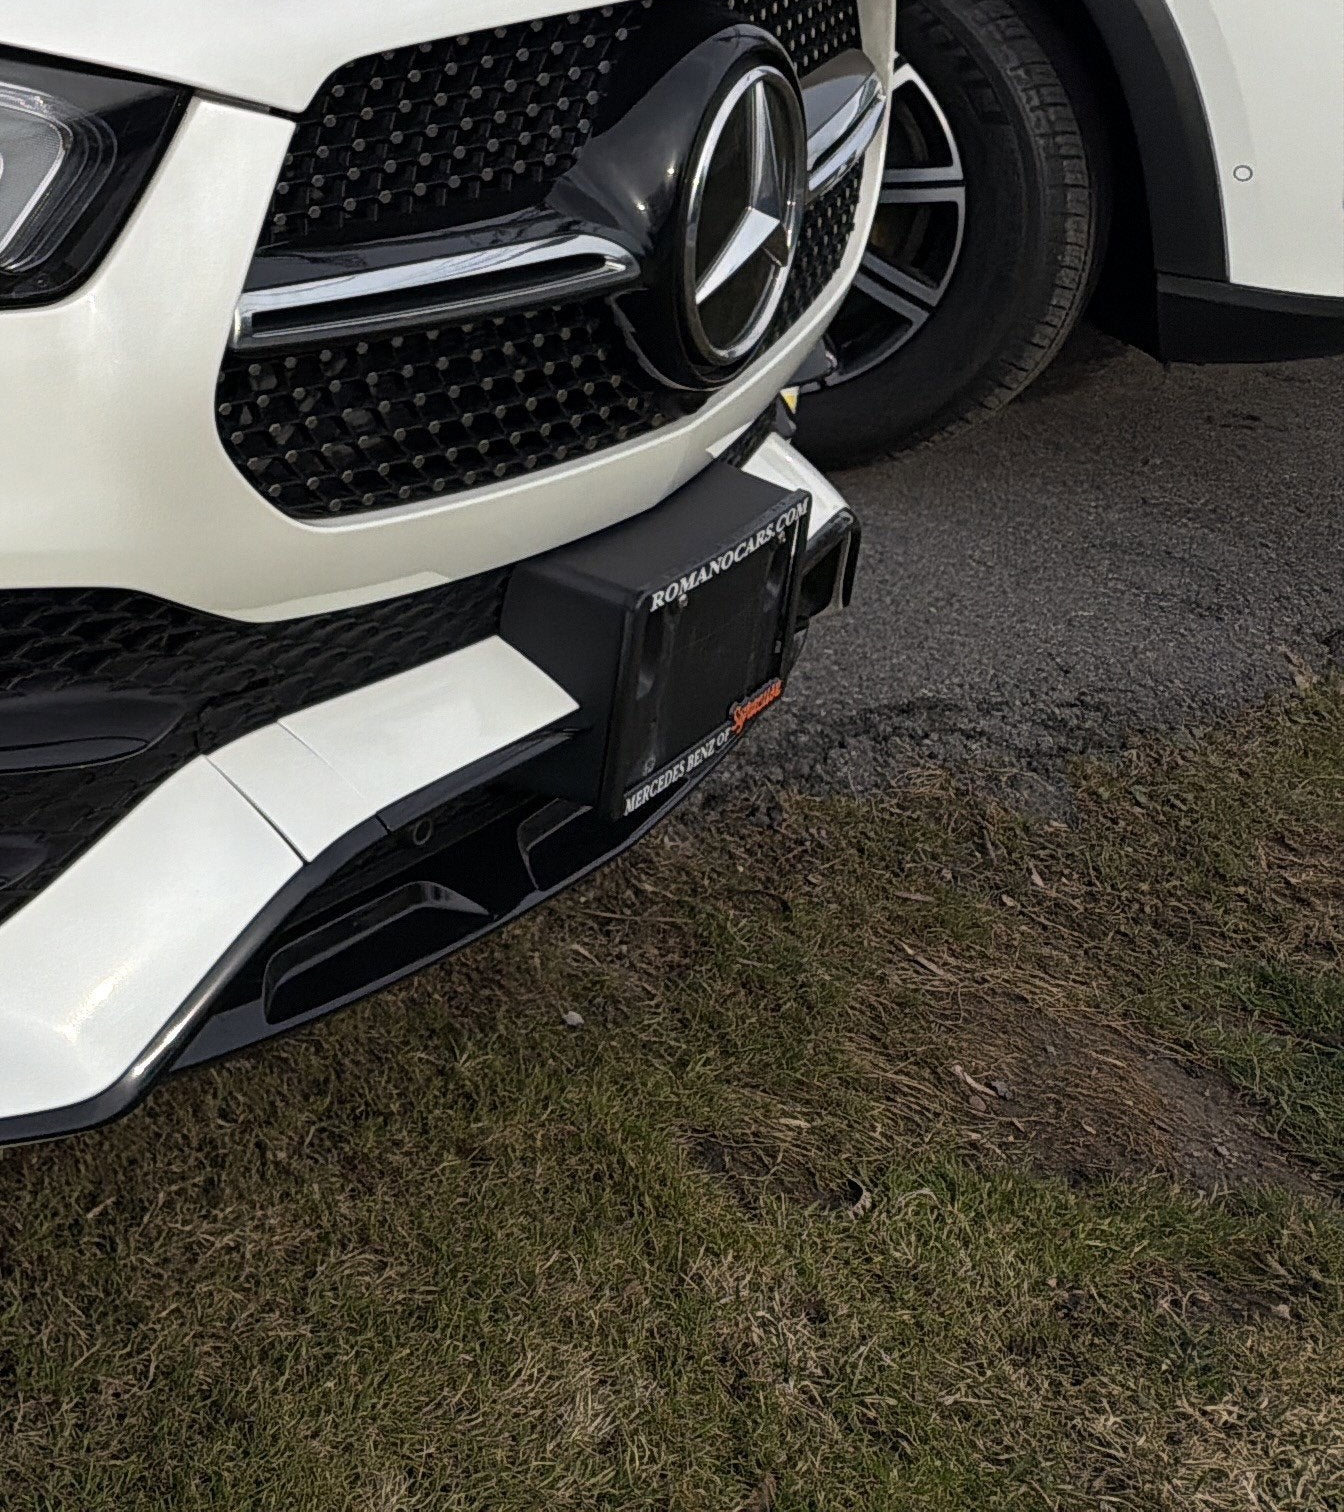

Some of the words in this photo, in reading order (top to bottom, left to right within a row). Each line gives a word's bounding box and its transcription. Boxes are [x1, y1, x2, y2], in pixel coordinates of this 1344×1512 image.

[649, 496, 810, 613] ROMANOCARS.COM
[623, 759, 686, 817] MERCEDES
[685, 736, 717, 774] BENZ
